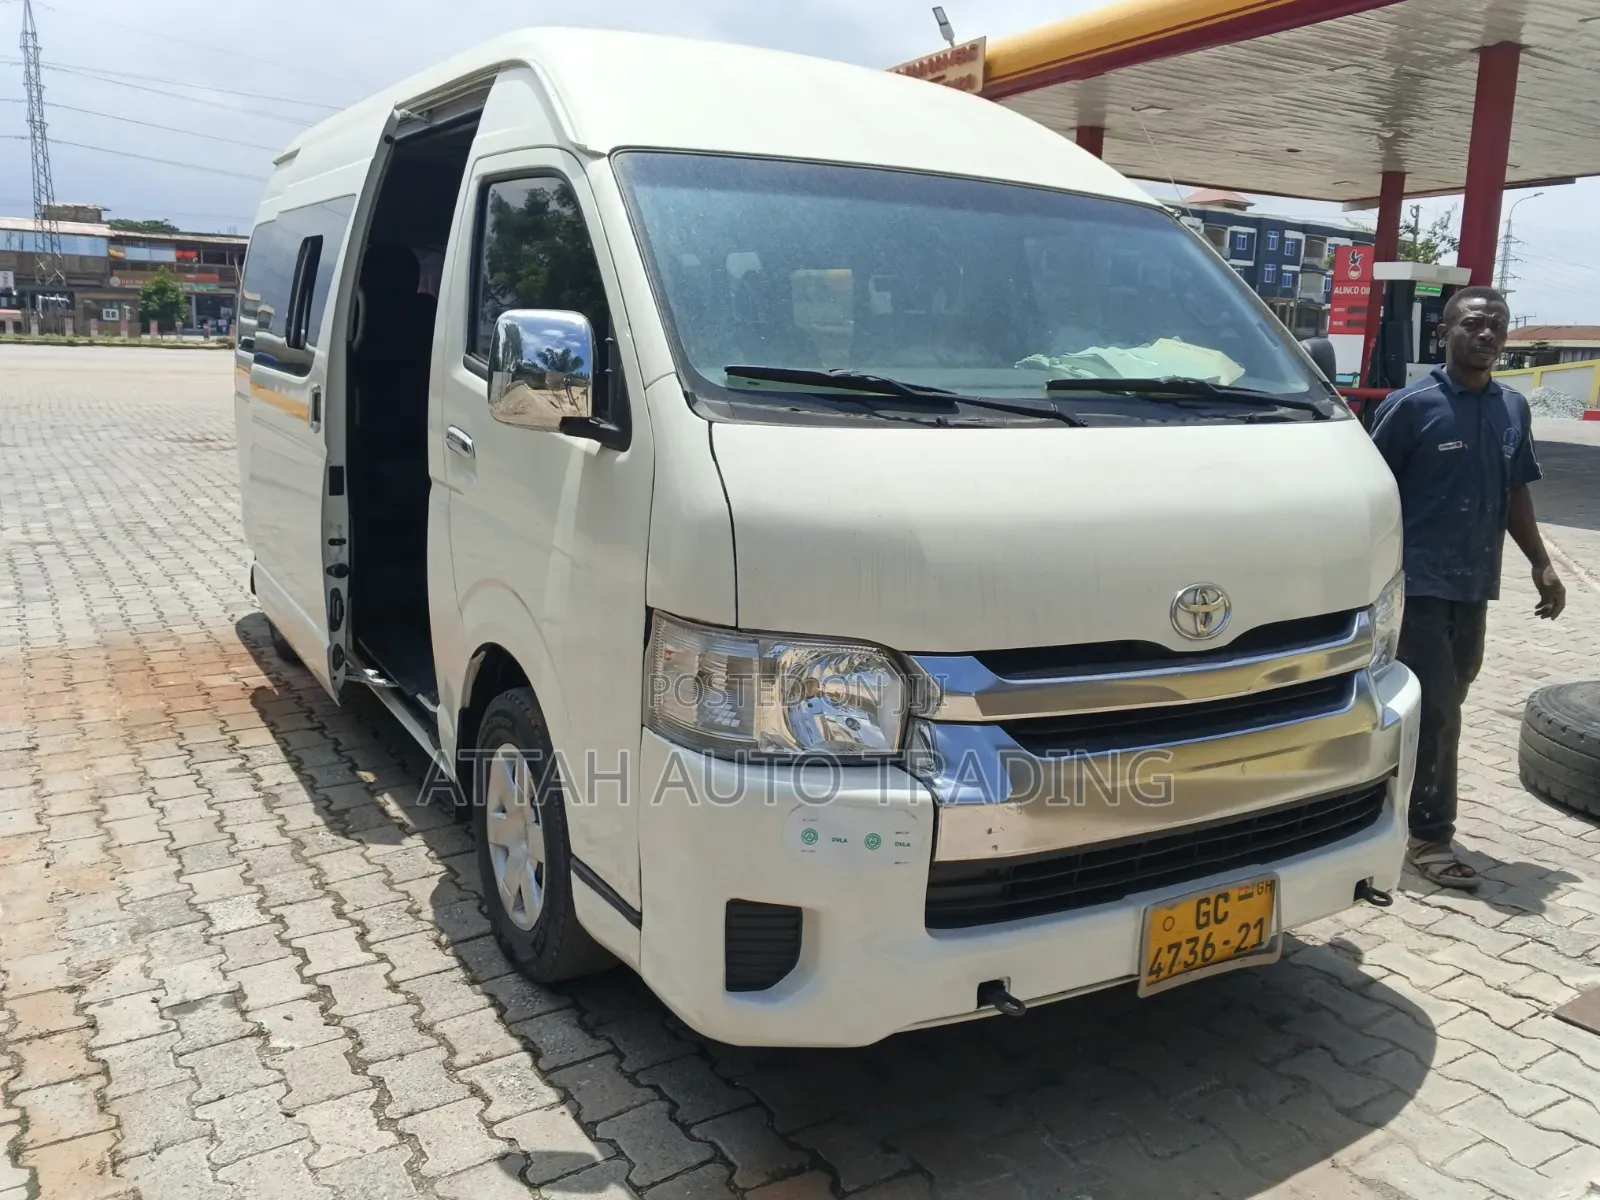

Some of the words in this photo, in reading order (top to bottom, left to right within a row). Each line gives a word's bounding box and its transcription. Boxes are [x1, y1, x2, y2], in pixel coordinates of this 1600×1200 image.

[1334, 286, 1359, 295] ALINCO
[1256, 880, 1273, 896] GH
[1195, 892, 1231, 931] GC
